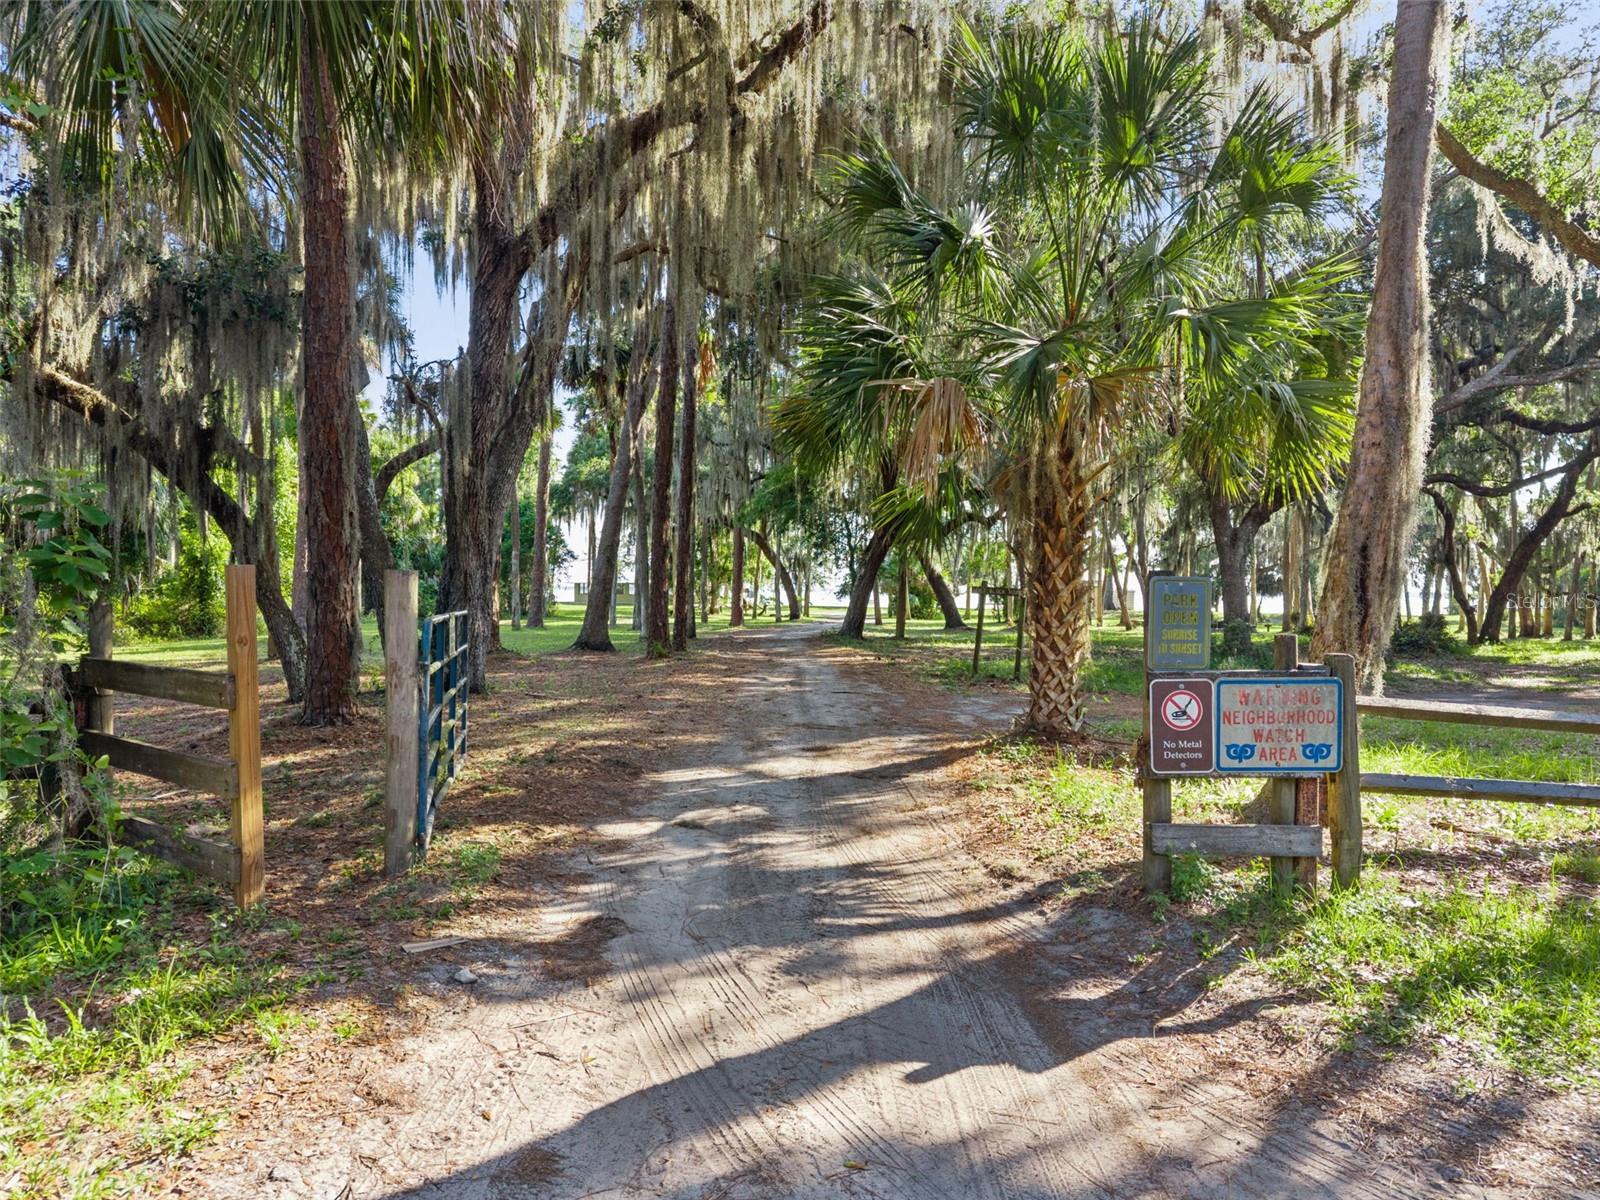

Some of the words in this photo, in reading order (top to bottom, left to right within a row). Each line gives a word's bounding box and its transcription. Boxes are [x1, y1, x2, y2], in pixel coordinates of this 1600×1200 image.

[1163, 593, 1198, 607] PARK
[1163, 611, 1199, 625] OPEN
[1162, 630, 1198, 641] SUNRISE
[1159, 643, 1168, 655] TO
[1169, 643, 1201, 655] SUNSET
[1223, 711, 1335, 725] NEIGHBORHOOD
[1253, 729, 1305, 743] WATCH
[1163, 740, 1176, 748] No
[1178, 740, 1202, 748] Metal
[1164, 751, 1203, 759] Detectors
[1259, 747, 1298, 761] AREA
